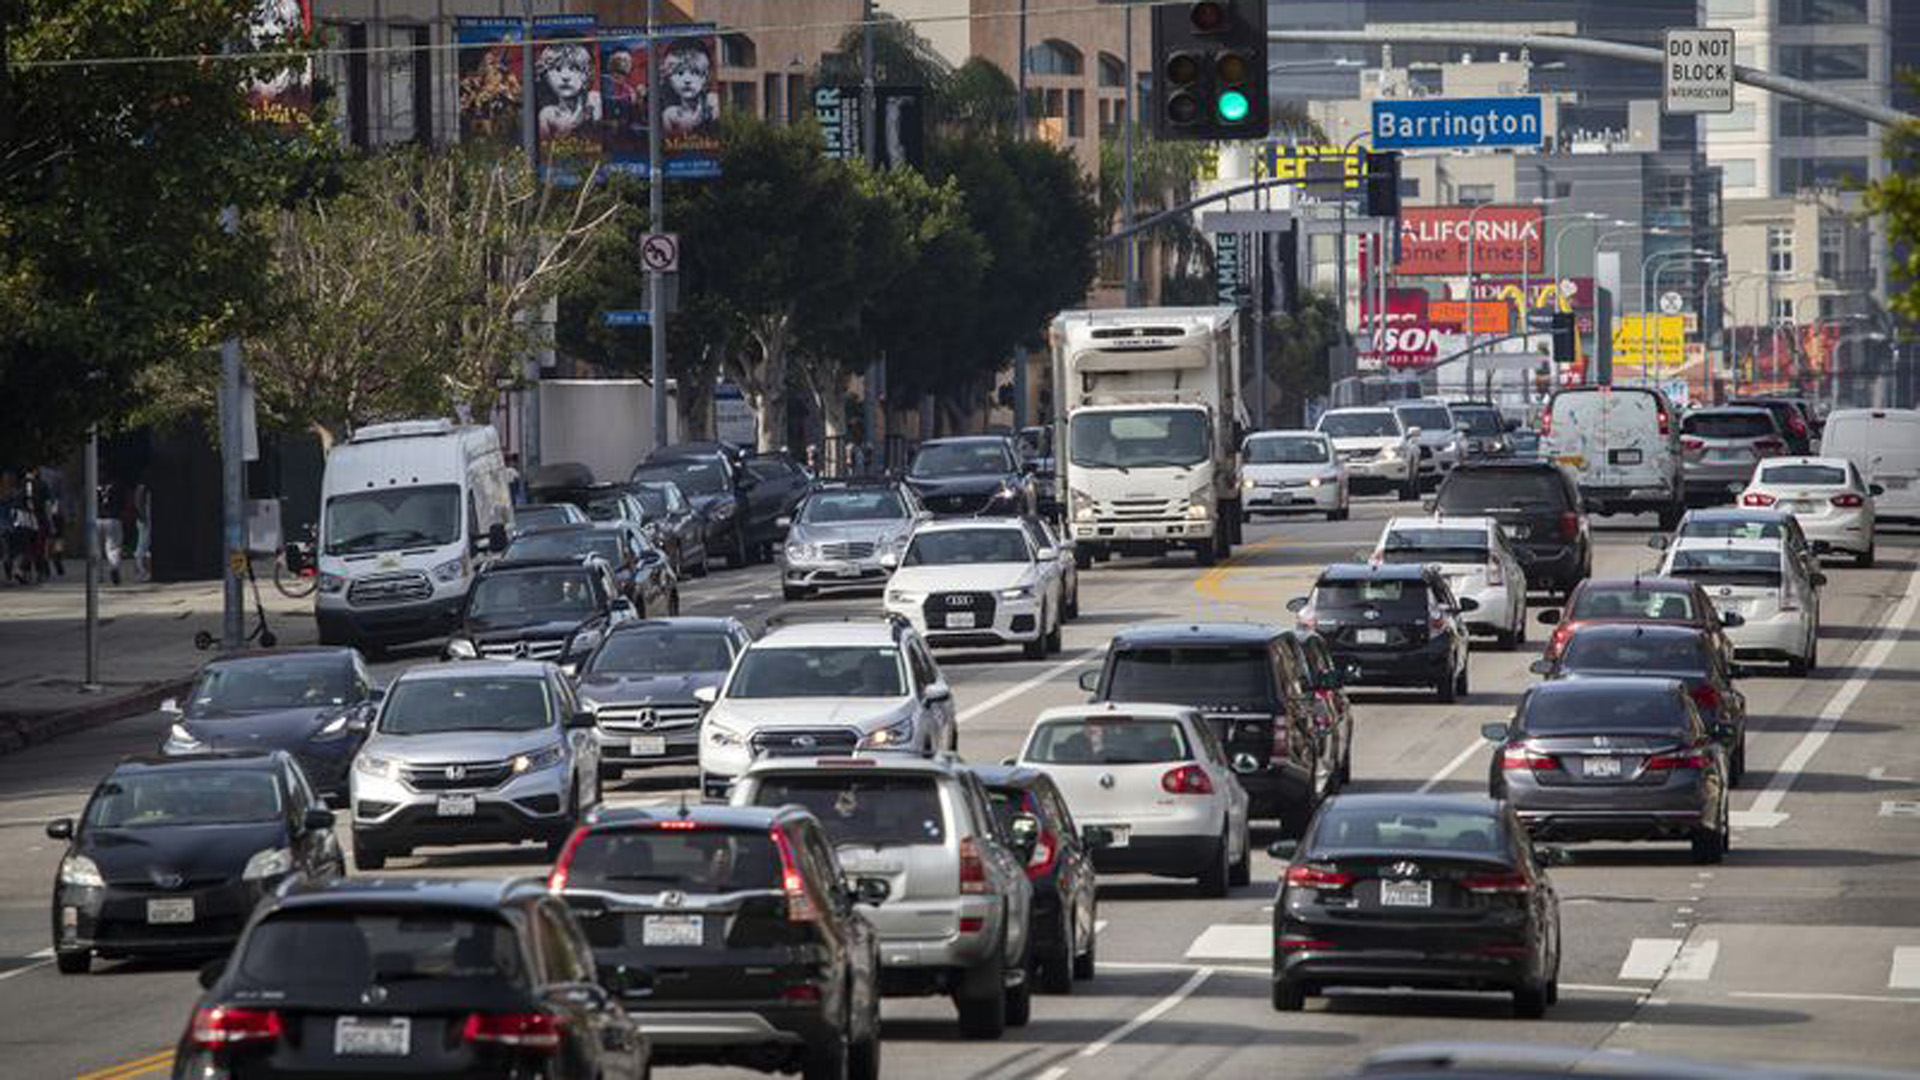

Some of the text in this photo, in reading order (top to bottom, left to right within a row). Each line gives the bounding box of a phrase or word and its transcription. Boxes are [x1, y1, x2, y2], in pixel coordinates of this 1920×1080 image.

[1670, 40, 1728, 56] DO NOT
[1673, 64, 1726, 80] BLOCK
[1378, 110, 1537, 143] Barrington
[1401, 219, 1538, 242] ALIFORNIA
[1458, 242, 1538, 261] Ftness
[1218, 232, 1237, 305] AMME
